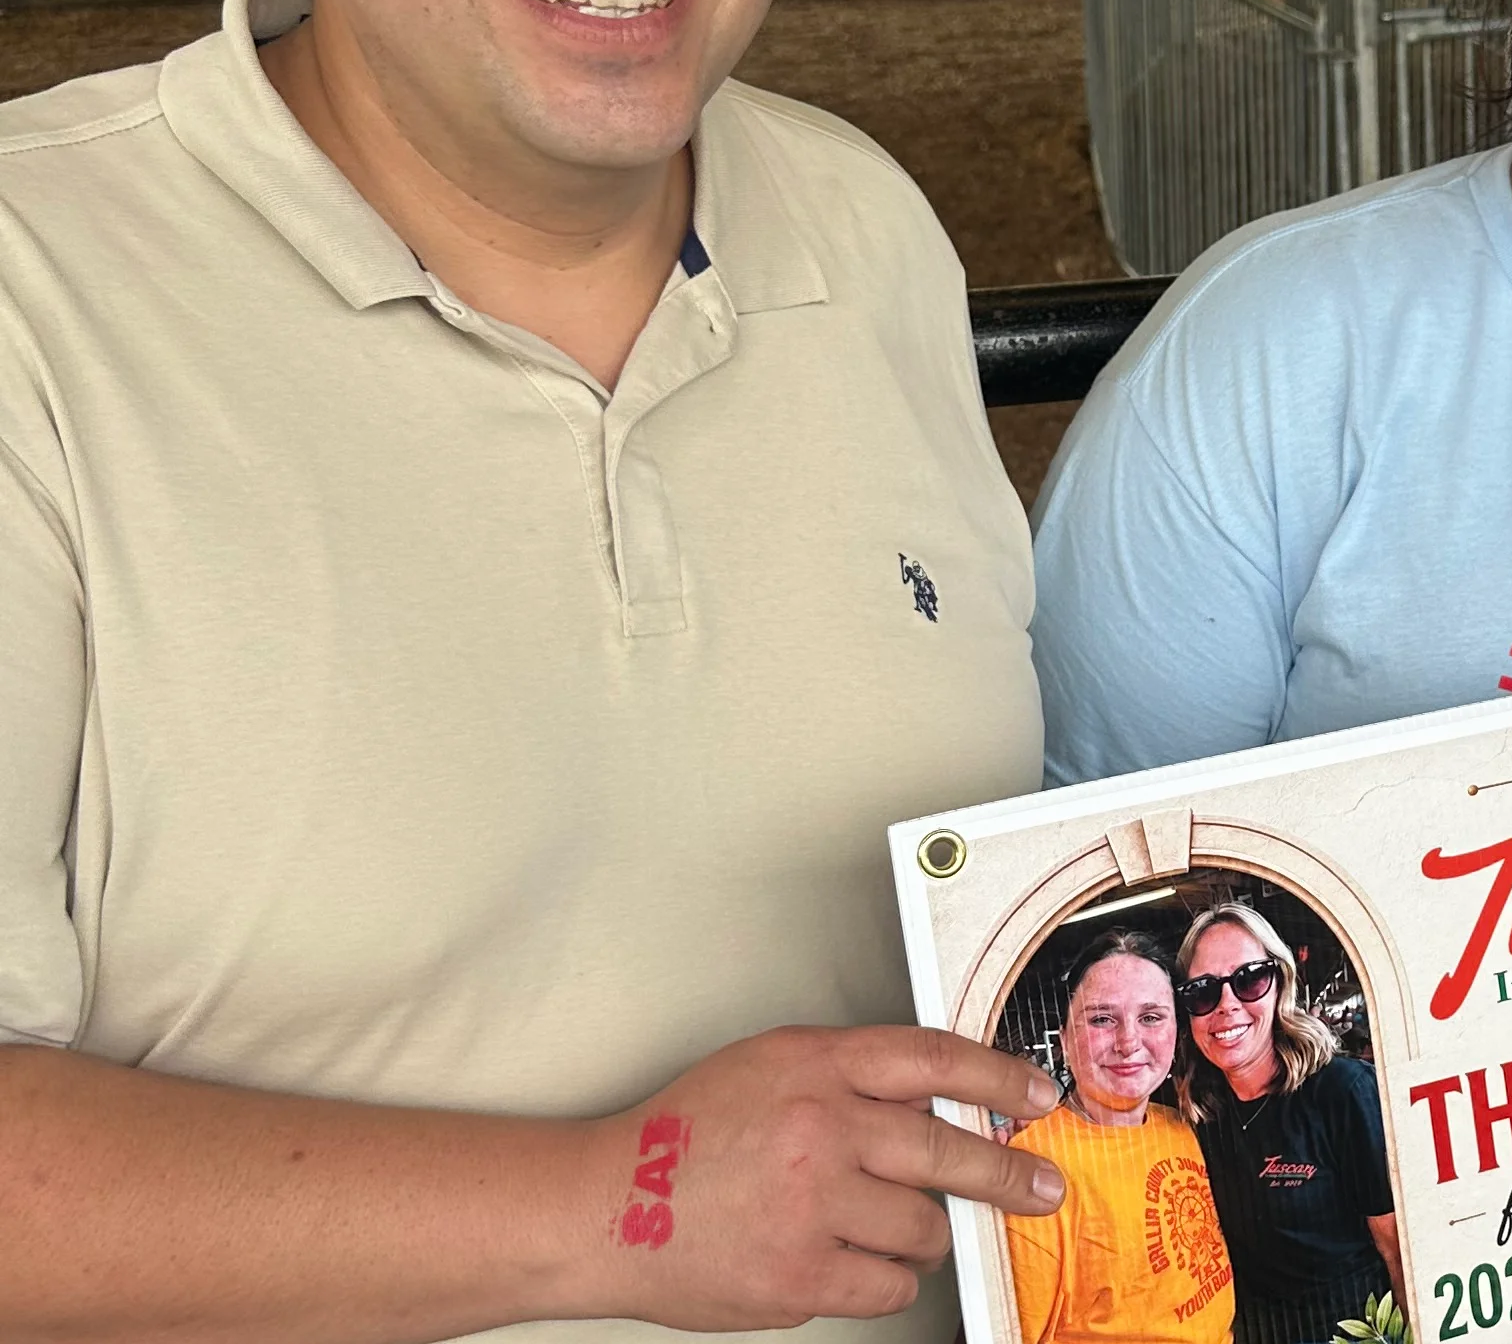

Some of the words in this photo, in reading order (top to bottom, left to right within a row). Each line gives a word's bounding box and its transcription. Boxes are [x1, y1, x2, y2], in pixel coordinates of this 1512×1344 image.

[1145, 1157, 1175, 1204] COUNTY
[1258, 1154, 1318, 1181] Tuscany
[1173, 1282, 1211, 1324] YOUTH
